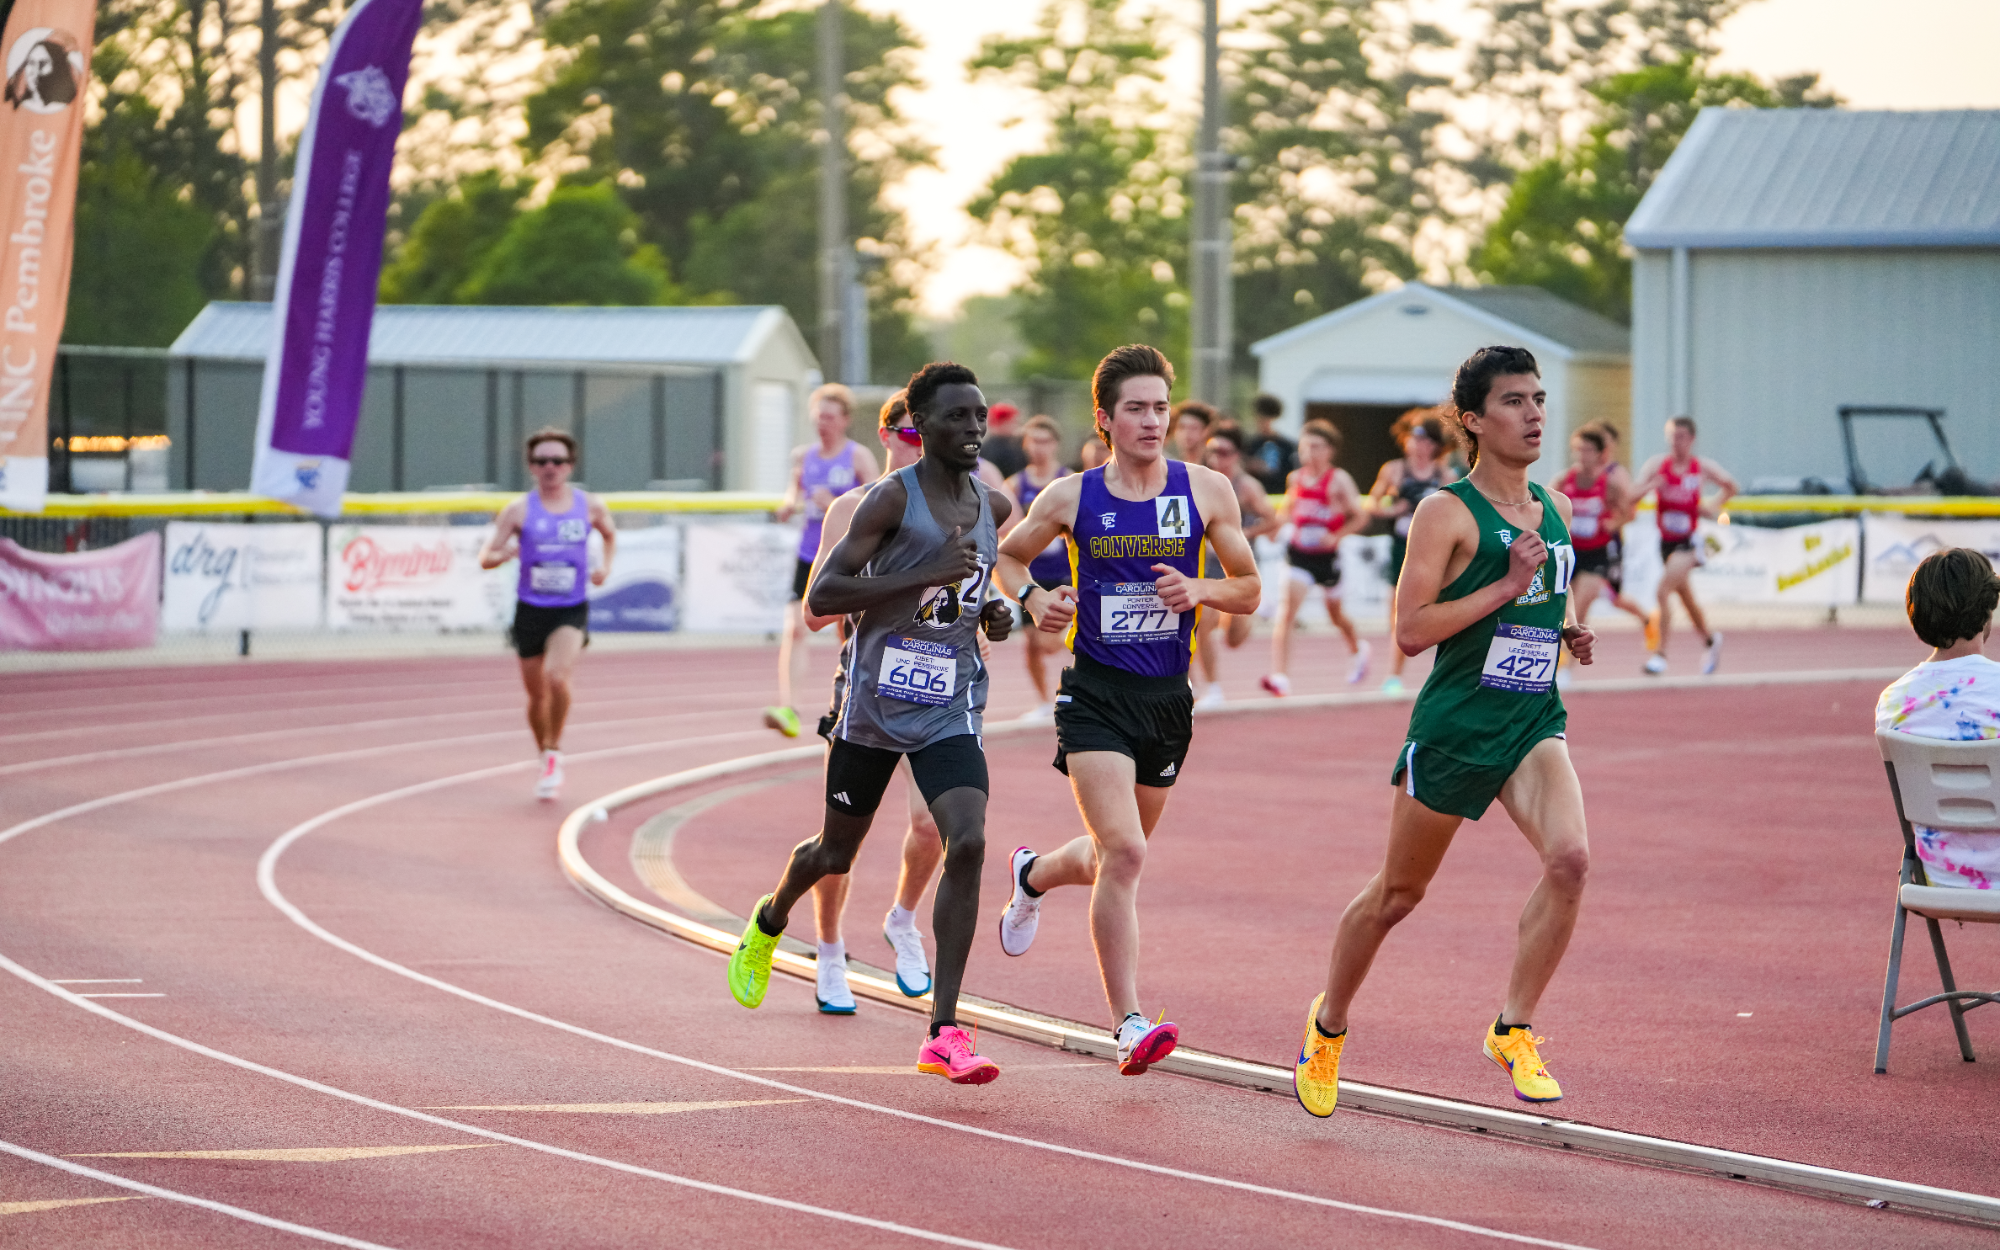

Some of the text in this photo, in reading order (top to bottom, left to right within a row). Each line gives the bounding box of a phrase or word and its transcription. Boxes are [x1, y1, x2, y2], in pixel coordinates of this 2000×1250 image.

[5, 129, 57, 334] Pembroke
[302, 345, 332, 431] YOUNG
[1160, 498, 1185, 535] 4
[1090, 535, 1186, 559] CONVERSE
[1559, 548, 1569, 590] 1
[961, 566, 984, 604] 2
[1111, 609, 1168, 631] 277
[901, 639, 952, 656] CAROLINAS
[1510, 629, 1559, 640] CAROLINAS
[889, 665, 947, 693] 606
[1496, 655, 1552, 680] 427
